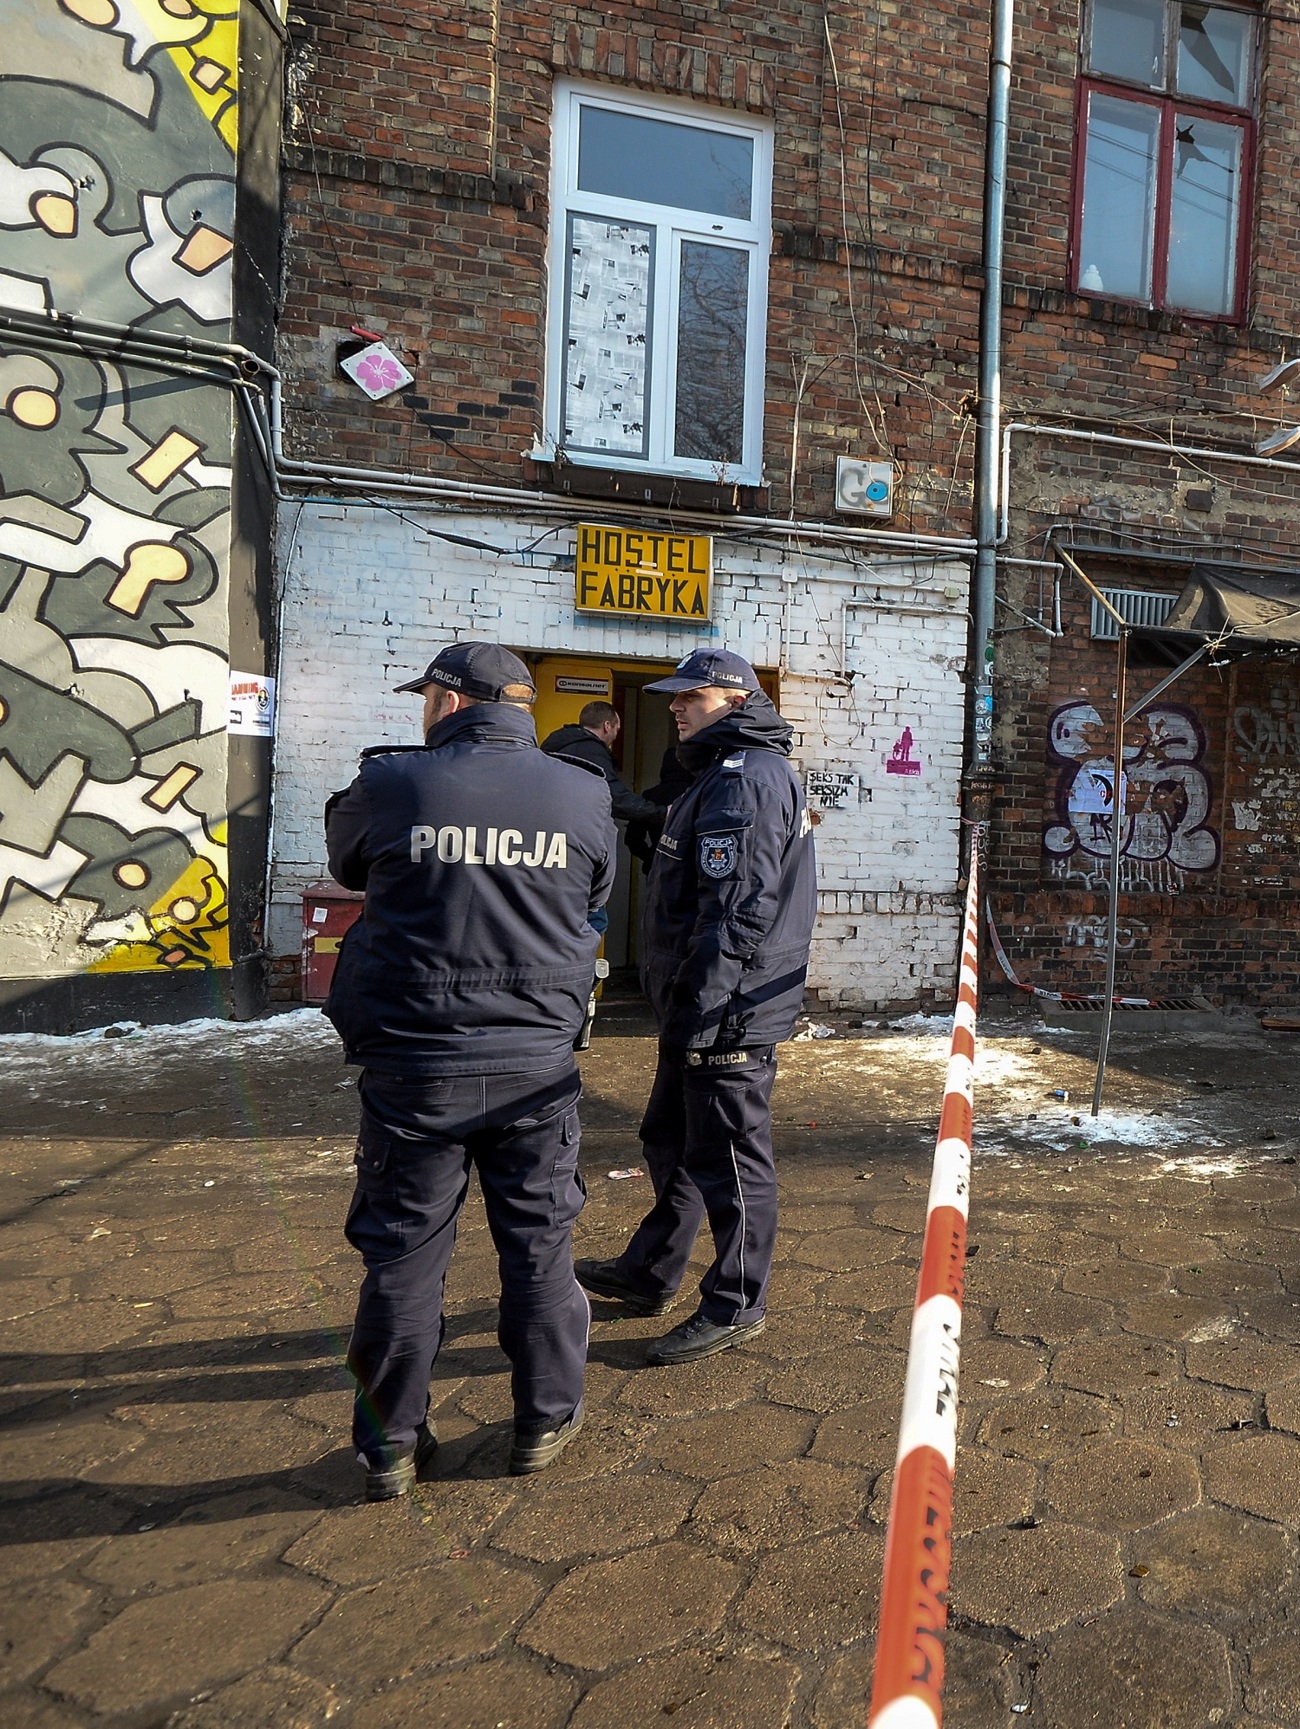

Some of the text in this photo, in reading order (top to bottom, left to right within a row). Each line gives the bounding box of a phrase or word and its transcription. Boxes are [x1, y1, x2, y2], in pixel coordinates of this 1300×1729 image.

[581, 528, 706, 574] HOSTEL
[580, 570, 705, 615] FABRYKA
[431, 668, 462, 687] POLICJA
[711, 670, 743, 684] POLICJA
[809, 772, 855, 786] SEKS TAK
[819, 796, 841, 807] NIE
[410, 825, 567, 869] POLICJA
[704, 838, 733, 847] POLICJA
[708, 1052, 748, 1066] POLICJA
